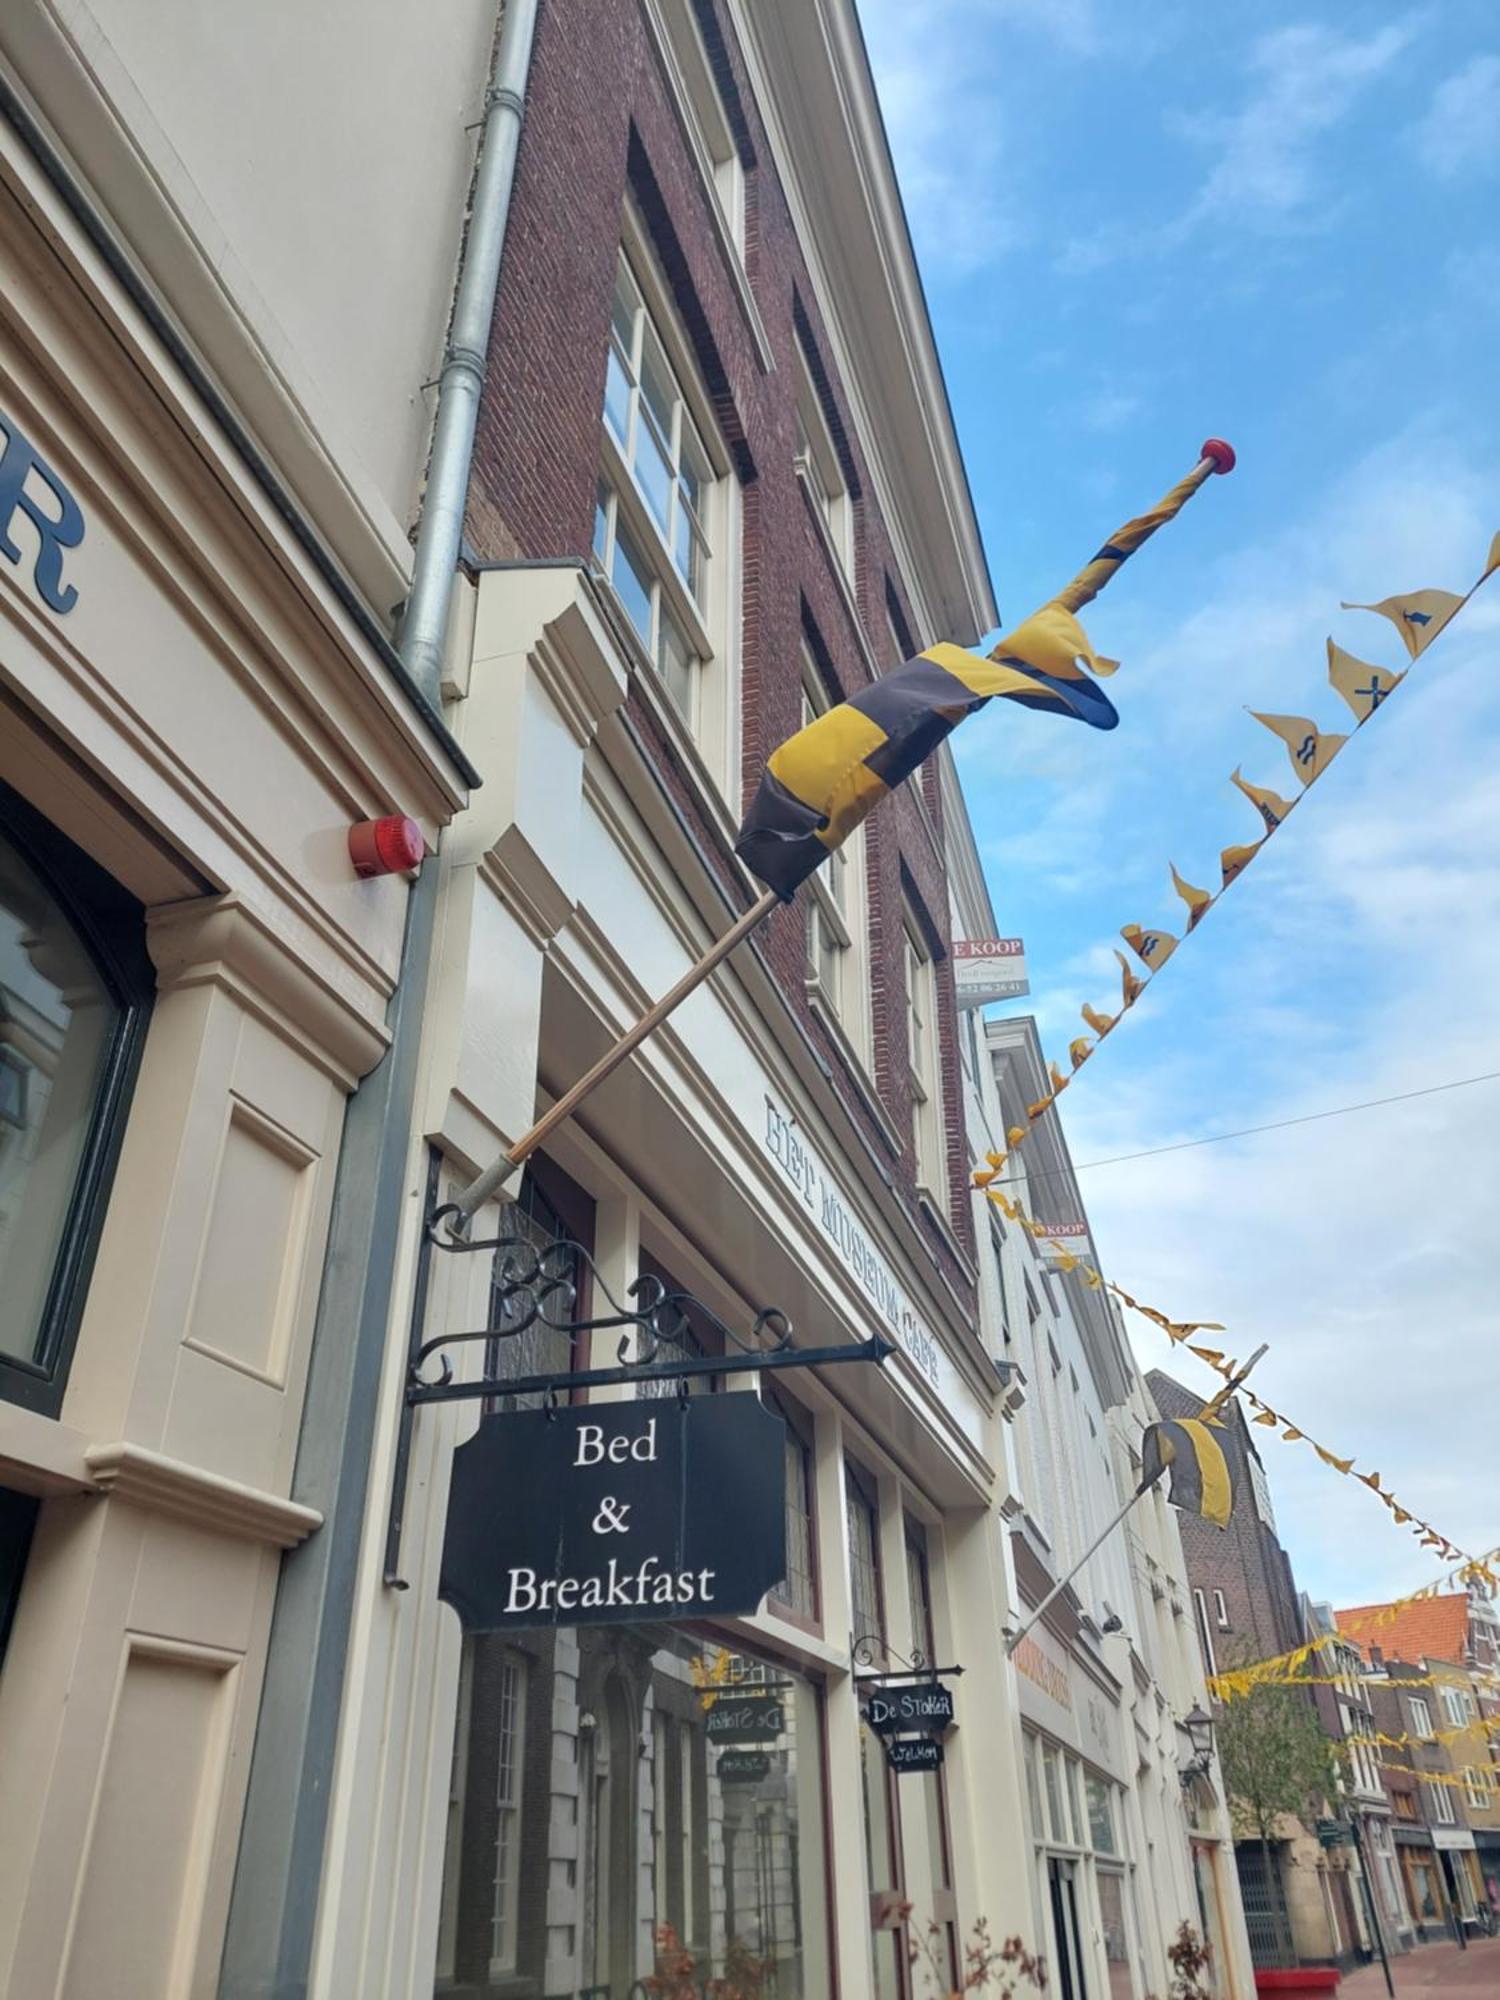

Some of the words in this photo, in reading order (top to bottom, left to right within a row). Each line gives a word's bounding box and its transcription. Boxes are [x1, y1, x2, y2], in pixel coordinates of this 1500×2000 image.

[970, 941, 1021, 955] KOOP
[1046, 1224, 1084, 1236] KOOP
[819, 1175, 900, 1334] MUSEUM
[573, 1418, 657, 1466] Bed
[592, 1496, 630, 1534] &
[503, 1556, 715, 1613] Breakfast
[872, 1700, 896, 1723] De
